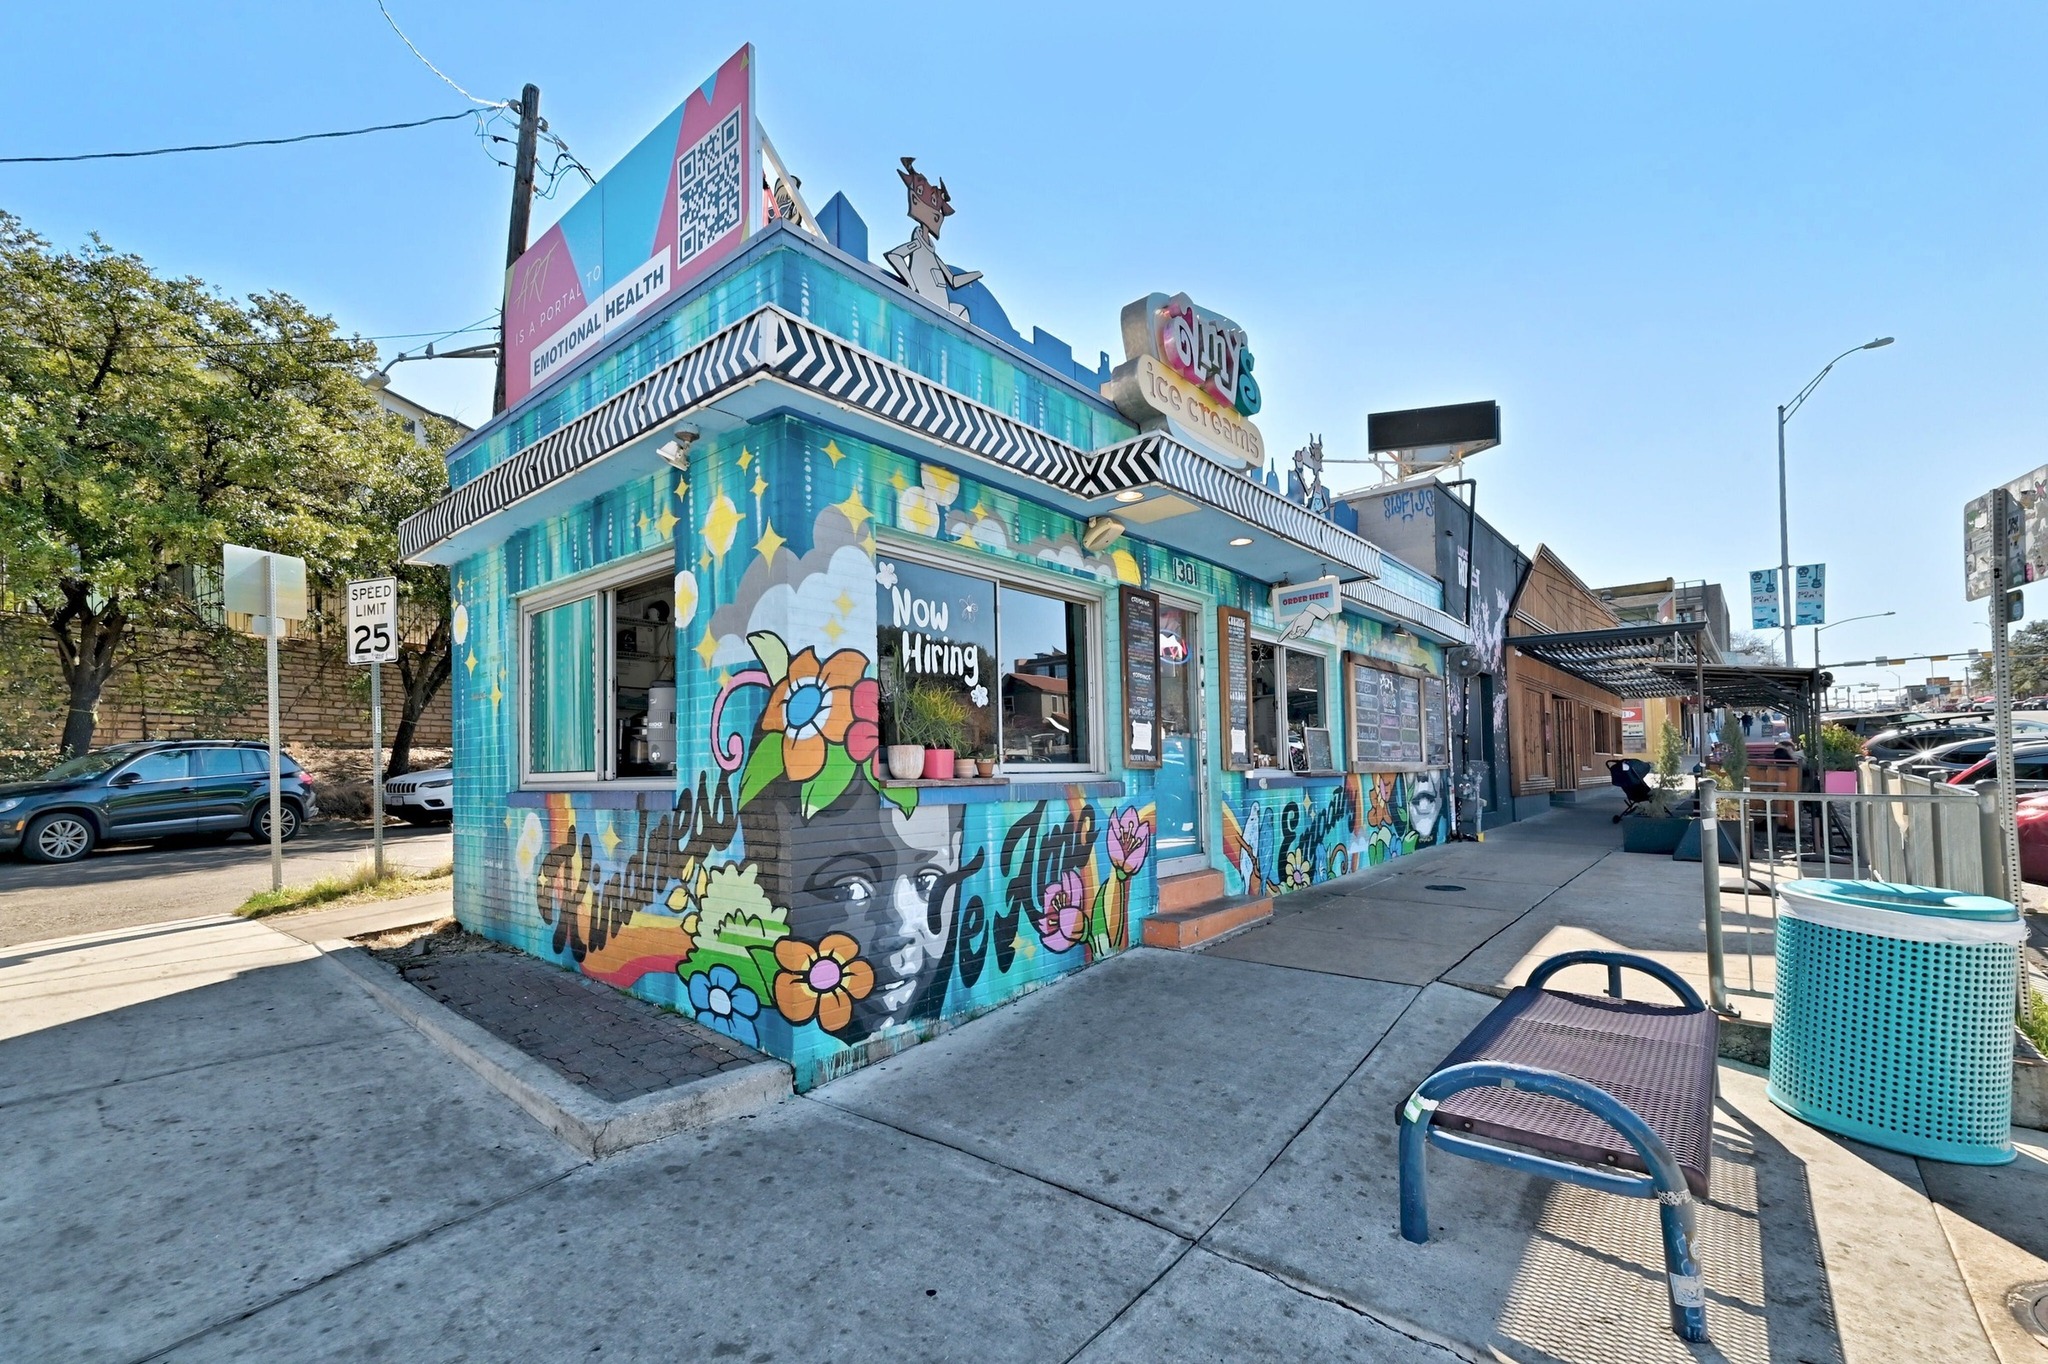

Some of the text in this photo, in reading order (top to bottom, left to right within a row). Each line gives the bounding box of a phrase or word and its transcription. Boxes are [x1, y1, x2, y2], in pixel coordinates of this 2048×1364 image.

[512, 241, 559, 313] ART
[515, 264, 601, 346] IS A PORTAL TO
[533, 264, 664, 377] EMOTIONAL HEALTH
[1146, 361, 1260, 459] ice creams
[351, 585, 392, 601] SPEED
[1172, 558, 1198, 586] 1301
[355, 602, 387, 618] LIMIT
[1282, 591, 1329, 606] ORDER HERE
[354, 622, 390, 655] 25
[902, 630, 979, 687] Hiring
